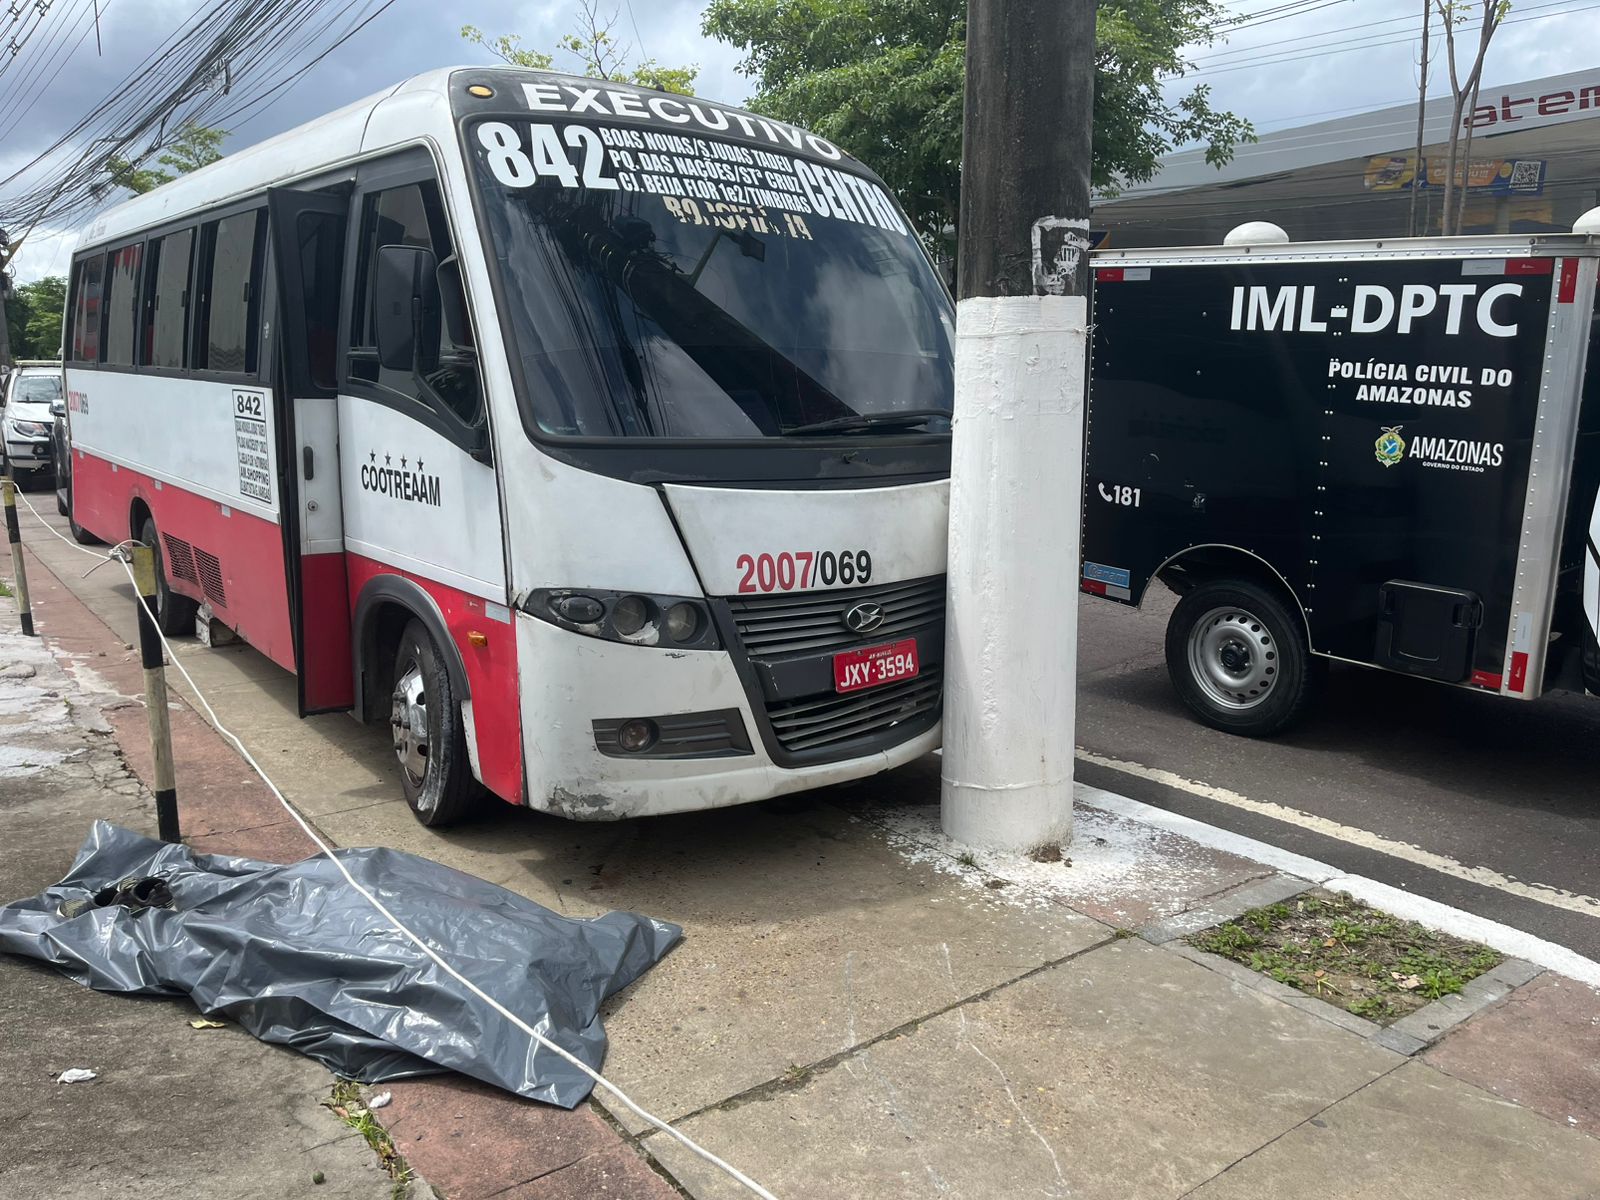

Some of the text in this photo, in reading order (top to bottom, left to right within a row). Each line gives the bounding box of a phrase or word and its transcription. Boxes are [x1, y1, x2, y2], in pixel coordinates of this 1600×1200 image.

[520, 83, 842, 161] EXECUTIVO
[477, 121, 620, 190] 842
[598, 127, 793, 173] BOAS NOVAS/S.JUDAS TADEU
[608, 149, 640, 172] PQ.
[637, 152, 675, 174] DAS
[764, 170, 804, 194] CRUZ
[618, 172, 813, 215] CJ. BEIJA FLOR 1e2/TIMBIRAS
[793, 158, 909, 237] CENTRO
[1230, 283, 1524, 337] IML-DPTC
[1328, 358, 1513, 387] POLÍCIA CIVIL DO
[237, 395, 262, 416] 842
[1355, 384, 1473, 408] AMAZONAS
[1409, 436, 1504, 467] AMAZONAS
[1422, 461, 1450, 469] GOVERNO
[1461, 465, 1484, 473] ESTADO
[361, 464, 441, 507] COOTREAAM
[1113, 485, 1141, 507] 181
[736, 550, 872, 593] 2007/069
